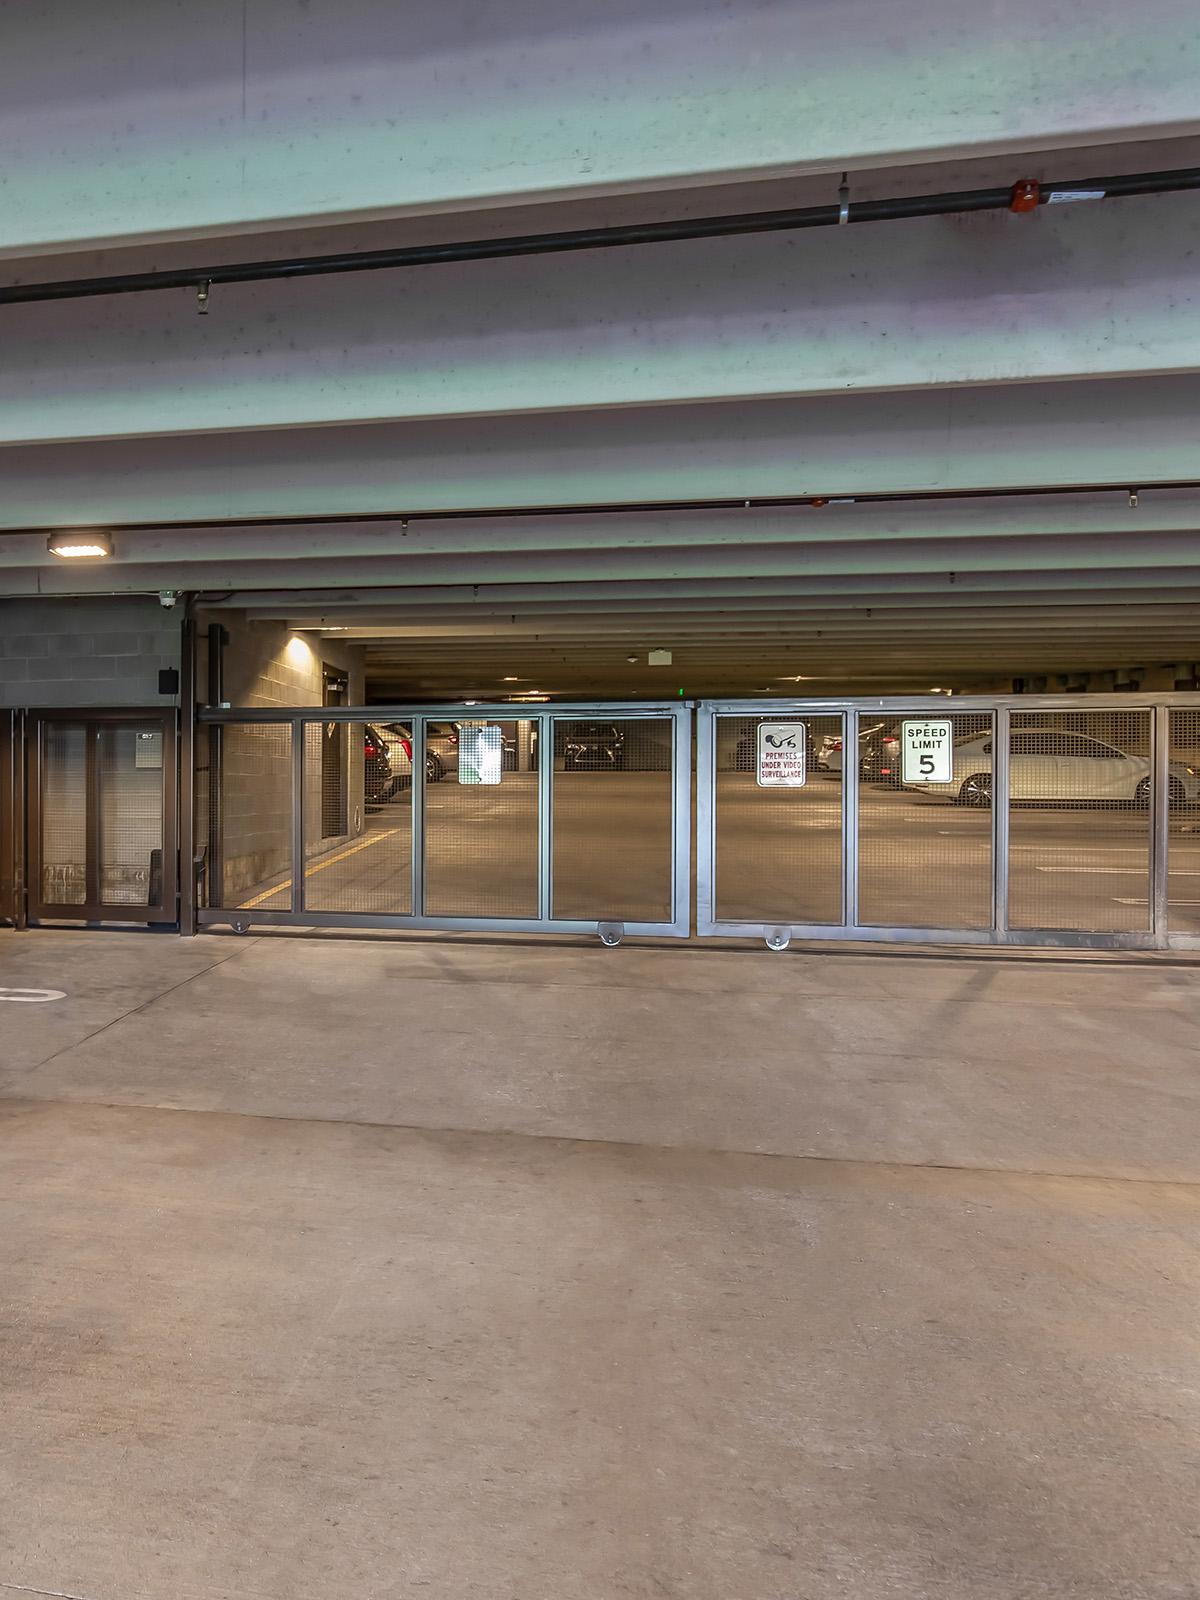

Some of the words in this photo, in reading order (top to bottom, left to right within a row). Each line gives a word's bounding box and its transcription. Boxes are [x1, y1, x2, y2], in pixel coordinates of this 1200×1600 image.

[908, 728, 947, 737] SPEED
[912, 740, 943, 748] LIMIT
[761, 761, 781, 769] UNDER
[784, 761, 802, 769] VIDEO
[919, 754, 935, 774] 5
[761, 770, 801, 778] SURVEILLANCE
